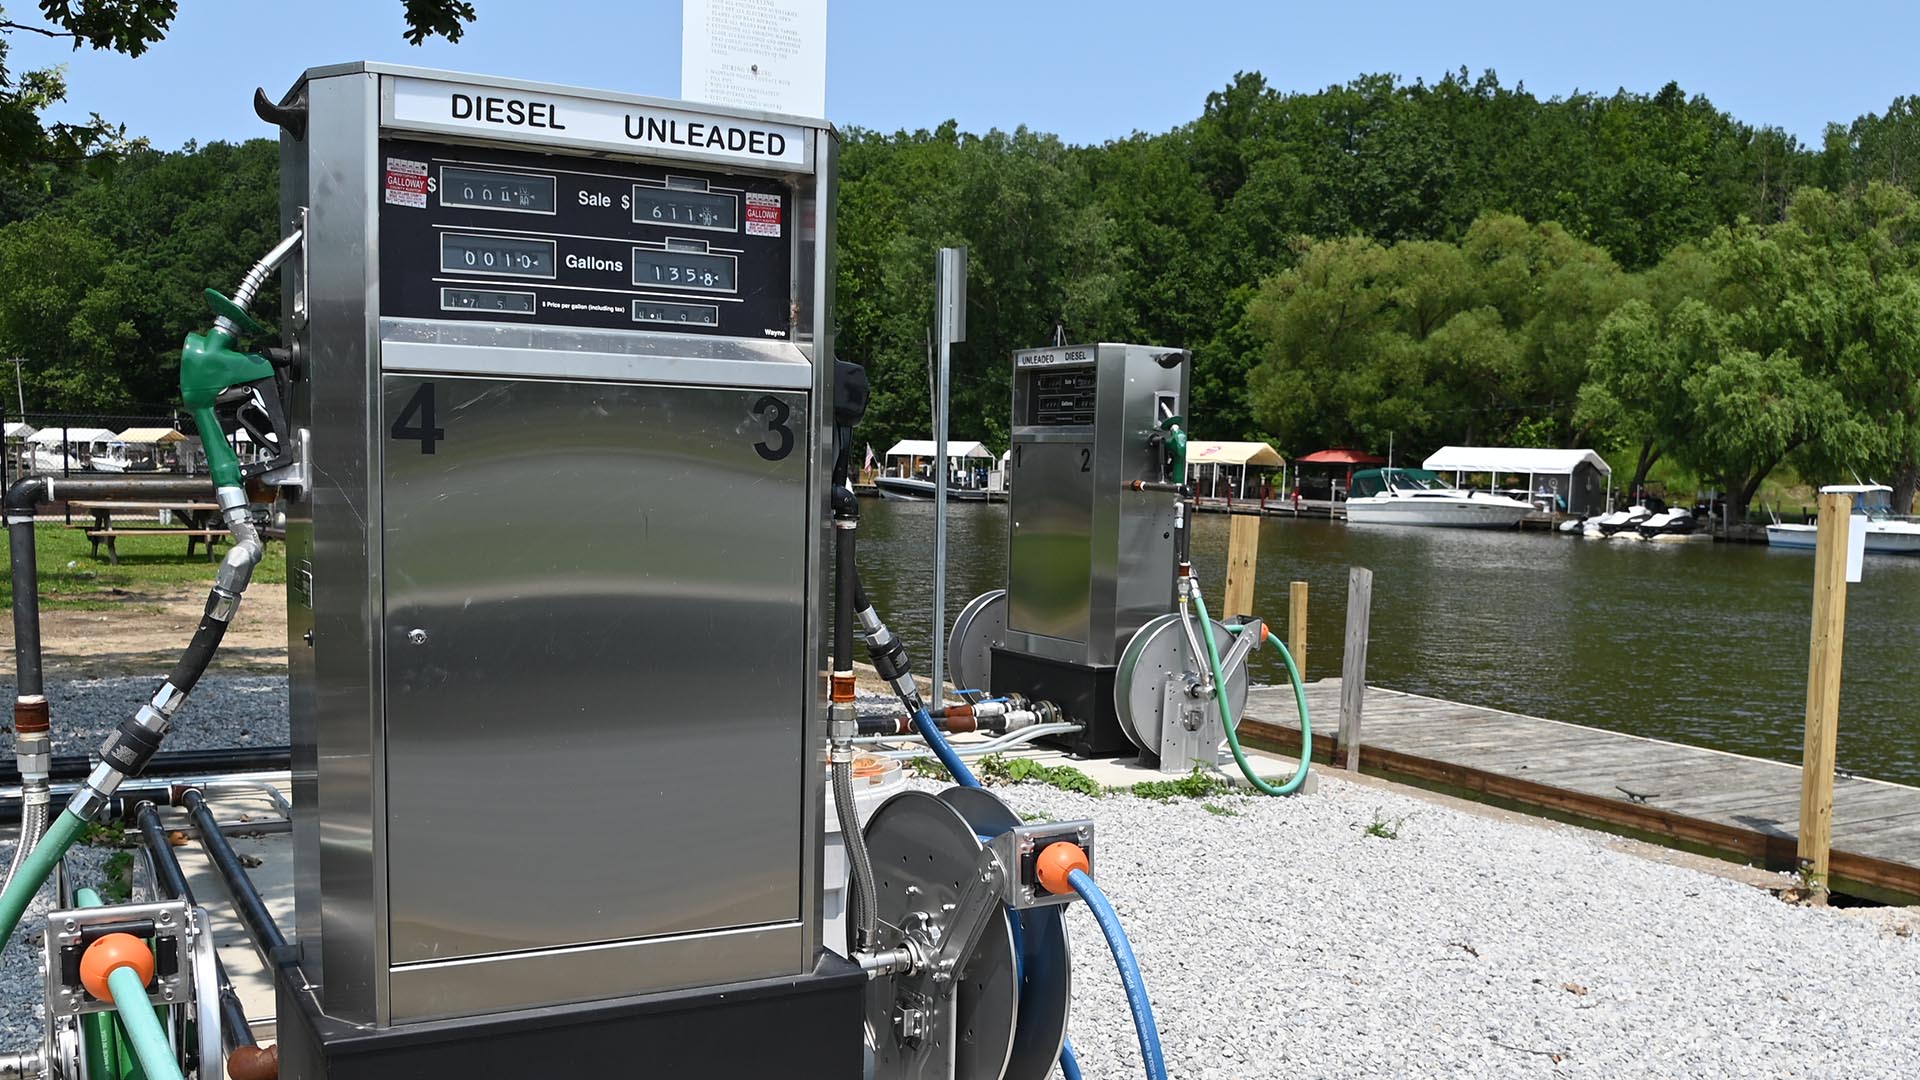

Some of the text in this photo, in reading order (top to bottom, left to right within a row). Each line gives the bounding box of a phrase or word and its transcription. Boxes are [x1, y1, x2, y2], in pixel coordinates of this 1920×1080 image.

[452, 93, 786, 156] DIESEL UNLEADED
[388, 176, 424, 189] GALLOWAY
[427, 176, 437, 193] $
[578, 190, 630, 210] Sale $
[748, 209, 778, 220] GALLOWAY
[565, 254, 623, 272] Gallons
[764, 328, 785, 337] Wayne
[1022, 351, 1086, 365] UNLEADED DIESEL
[392, 383, 444, 454] 4
[753, 395, 794, 460] 3
[1016, 445, 1022, 468] 1
[1081, 448, 1090, 472] 2
